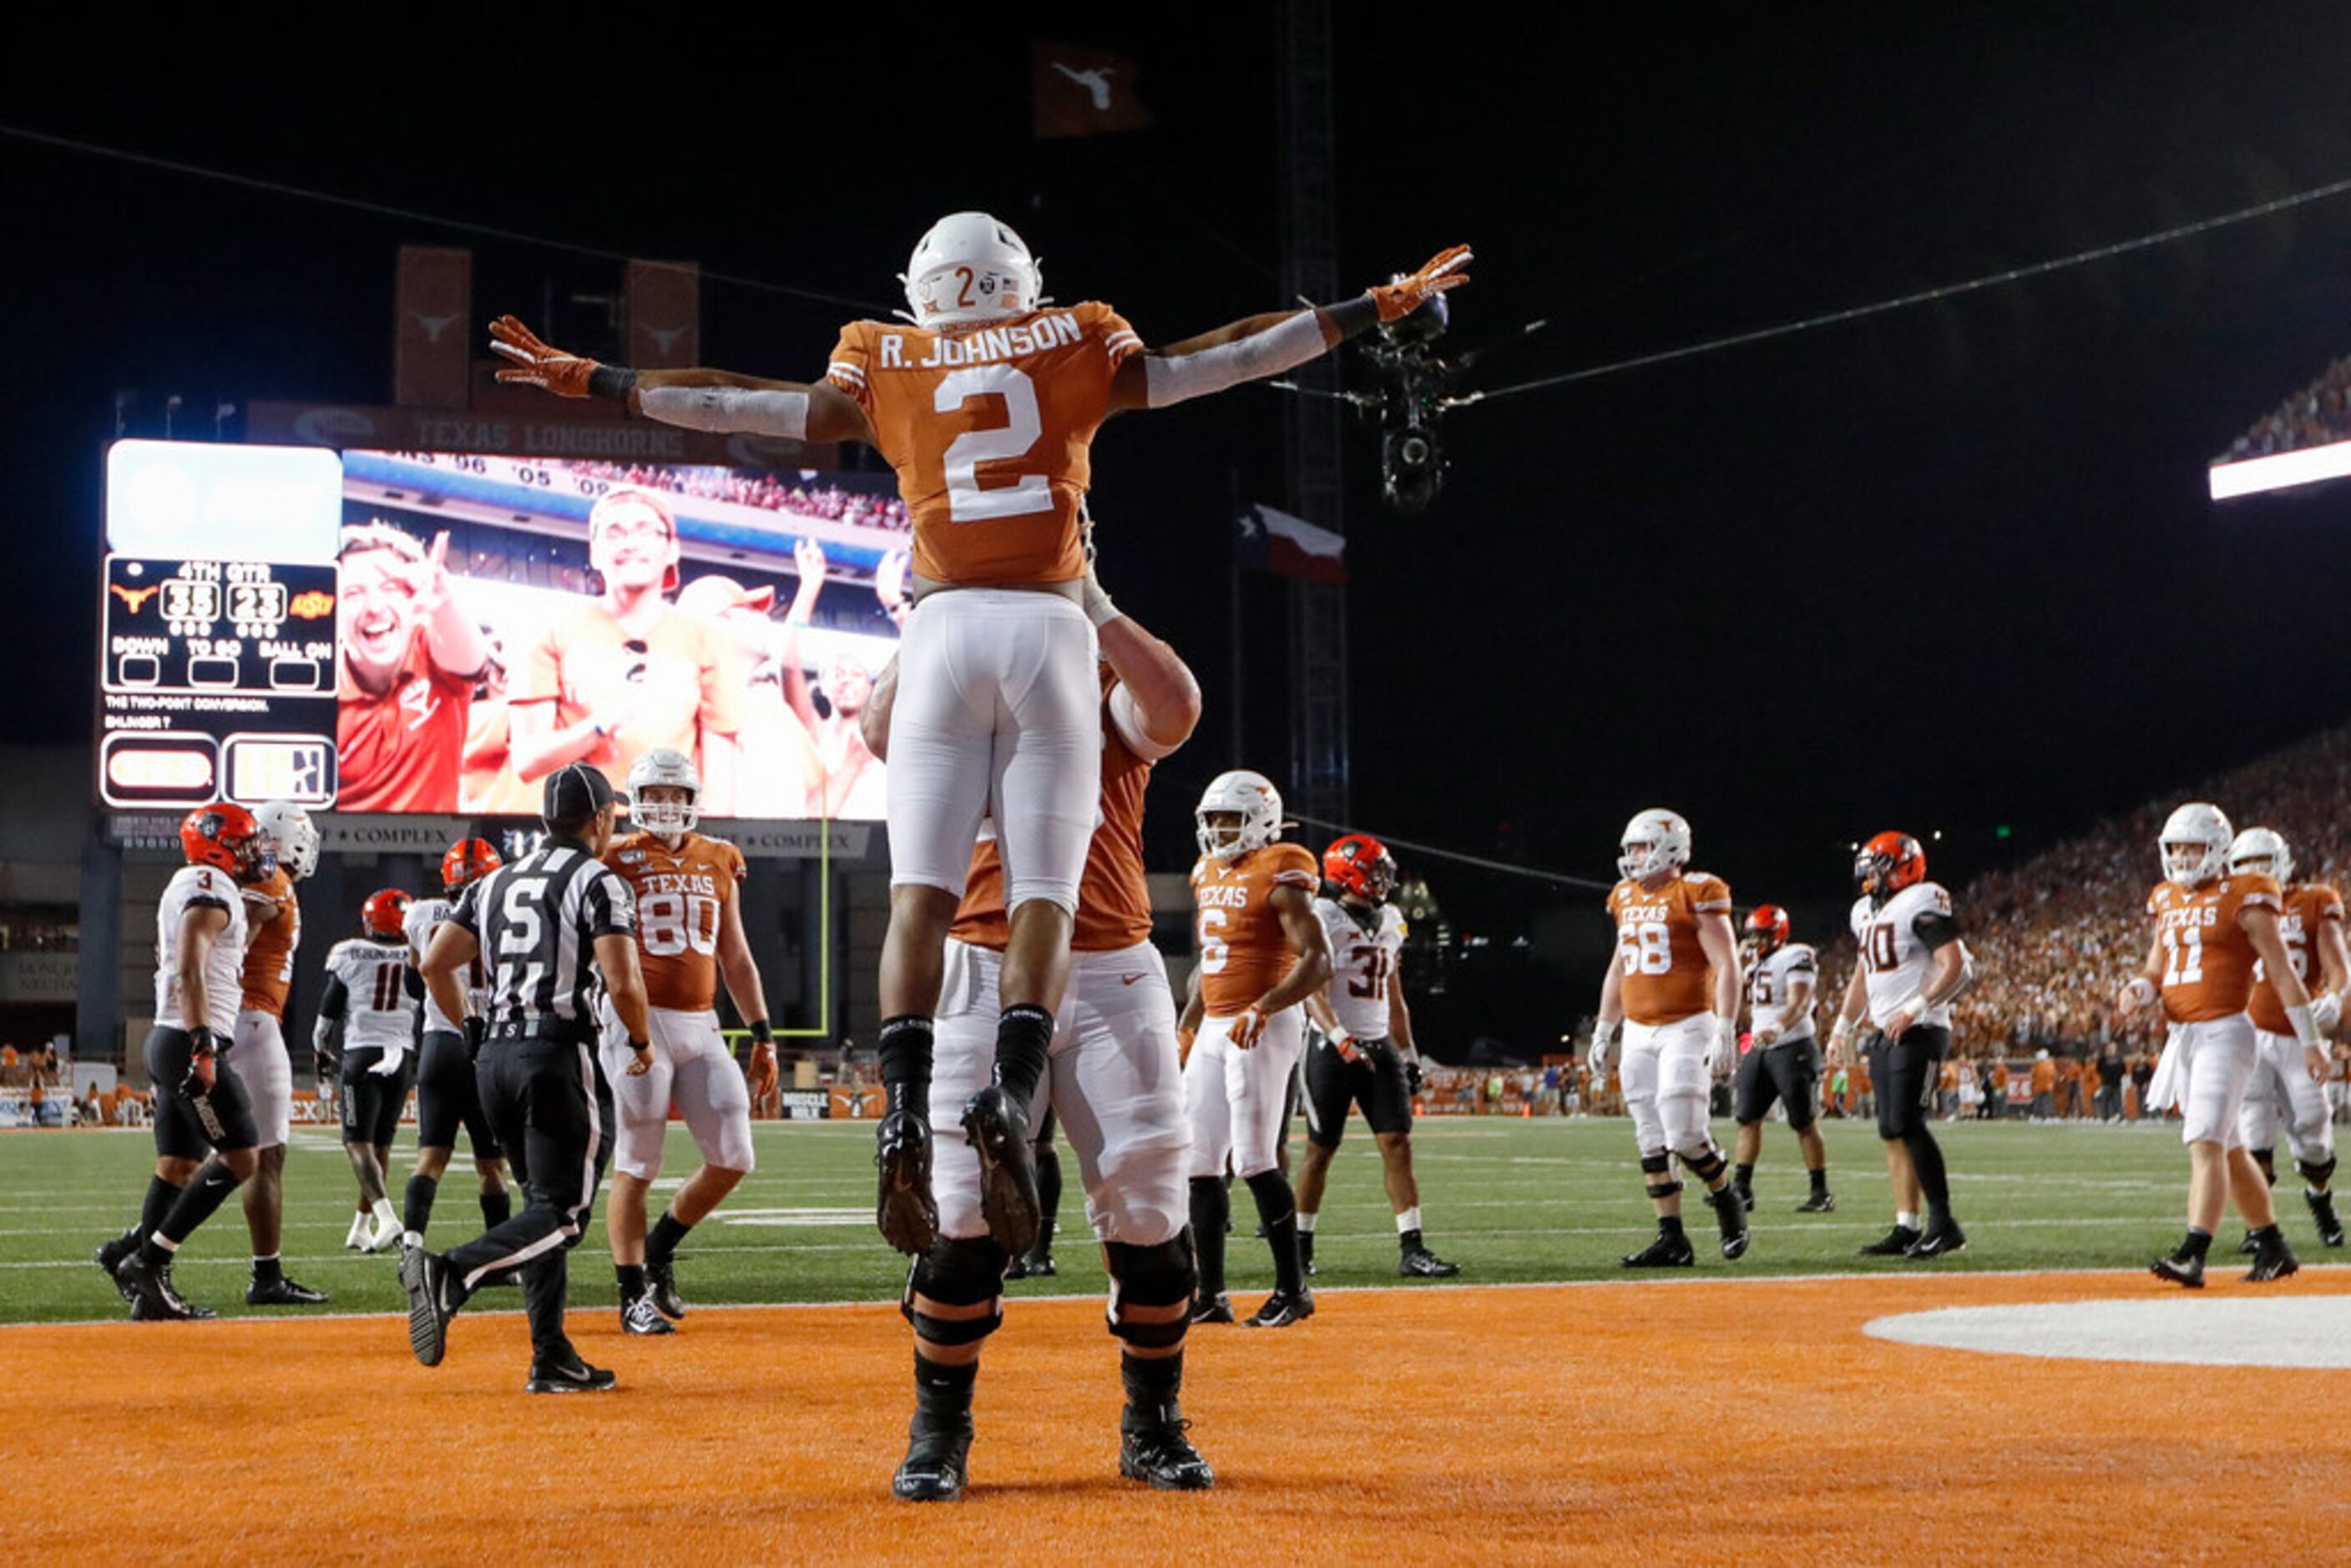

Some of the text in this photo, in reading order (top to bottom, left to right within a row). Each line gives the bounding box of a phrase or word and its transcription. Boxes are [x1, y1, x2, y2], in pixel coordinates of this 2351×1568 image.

[954, 266, 976, 308] 2
[880, 312, 1083, 367] R. JOHNSON
[417, 419, 685, 456] TEXAS LONGHORNS
[933, 363, 1055, 523] 2
[512, 465, 551, 487] '05
[178, 561, 271, 584] 4TH QTR
[235, 586, 280, 620] 23
[112, 636, 169, 655] DOWN
[259, 640, 302, 658] BALL
[305, 642, 332, 660] ON
[105, 695, 129, 709] THE
[129, 695, 192, 710] TWO-POINT
[355, 827, 448, 843] COMPLEX
[197, 870, 213, 891] 3
[642, 874, 715, 894] TEXAS
[500, 878, 549, 953] S
[639, 893, 720, 956] 80
[1621, 906, 1669, 923] TEXAS
[2159, 907, 2217, 931] TEXAS
[1199, 908, 1229, 974] 6
[2161, 926, 2203, 987] 11
[372, 963, 402, 1011] 11
[504, 1023, 518, 1038] S
